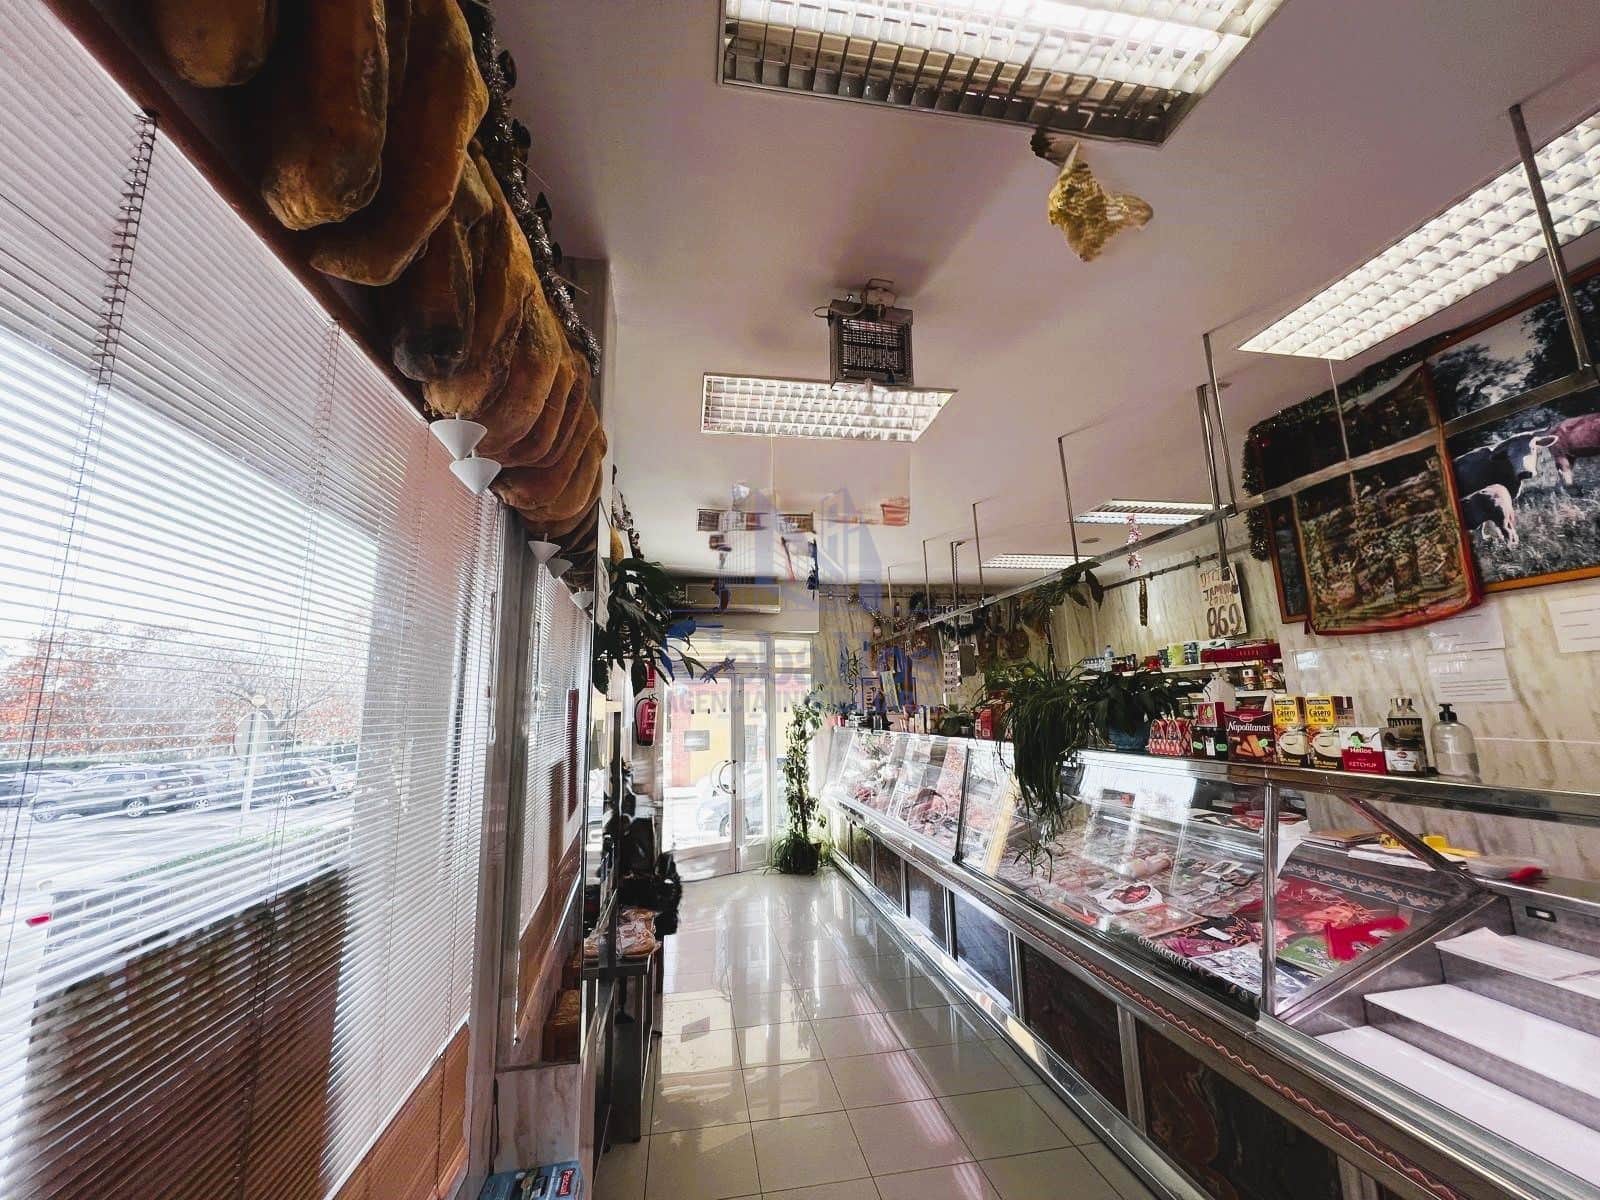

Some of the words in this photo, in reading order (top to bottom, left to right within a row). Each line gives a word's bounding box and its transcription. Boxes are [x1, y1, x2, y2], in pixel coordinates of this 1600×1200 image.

[1309, 709, 1331, 718] Casero
[1226, 720, 1272, 733] Napolitanas
[1348, 761, 1377, 769] KETCHUP
